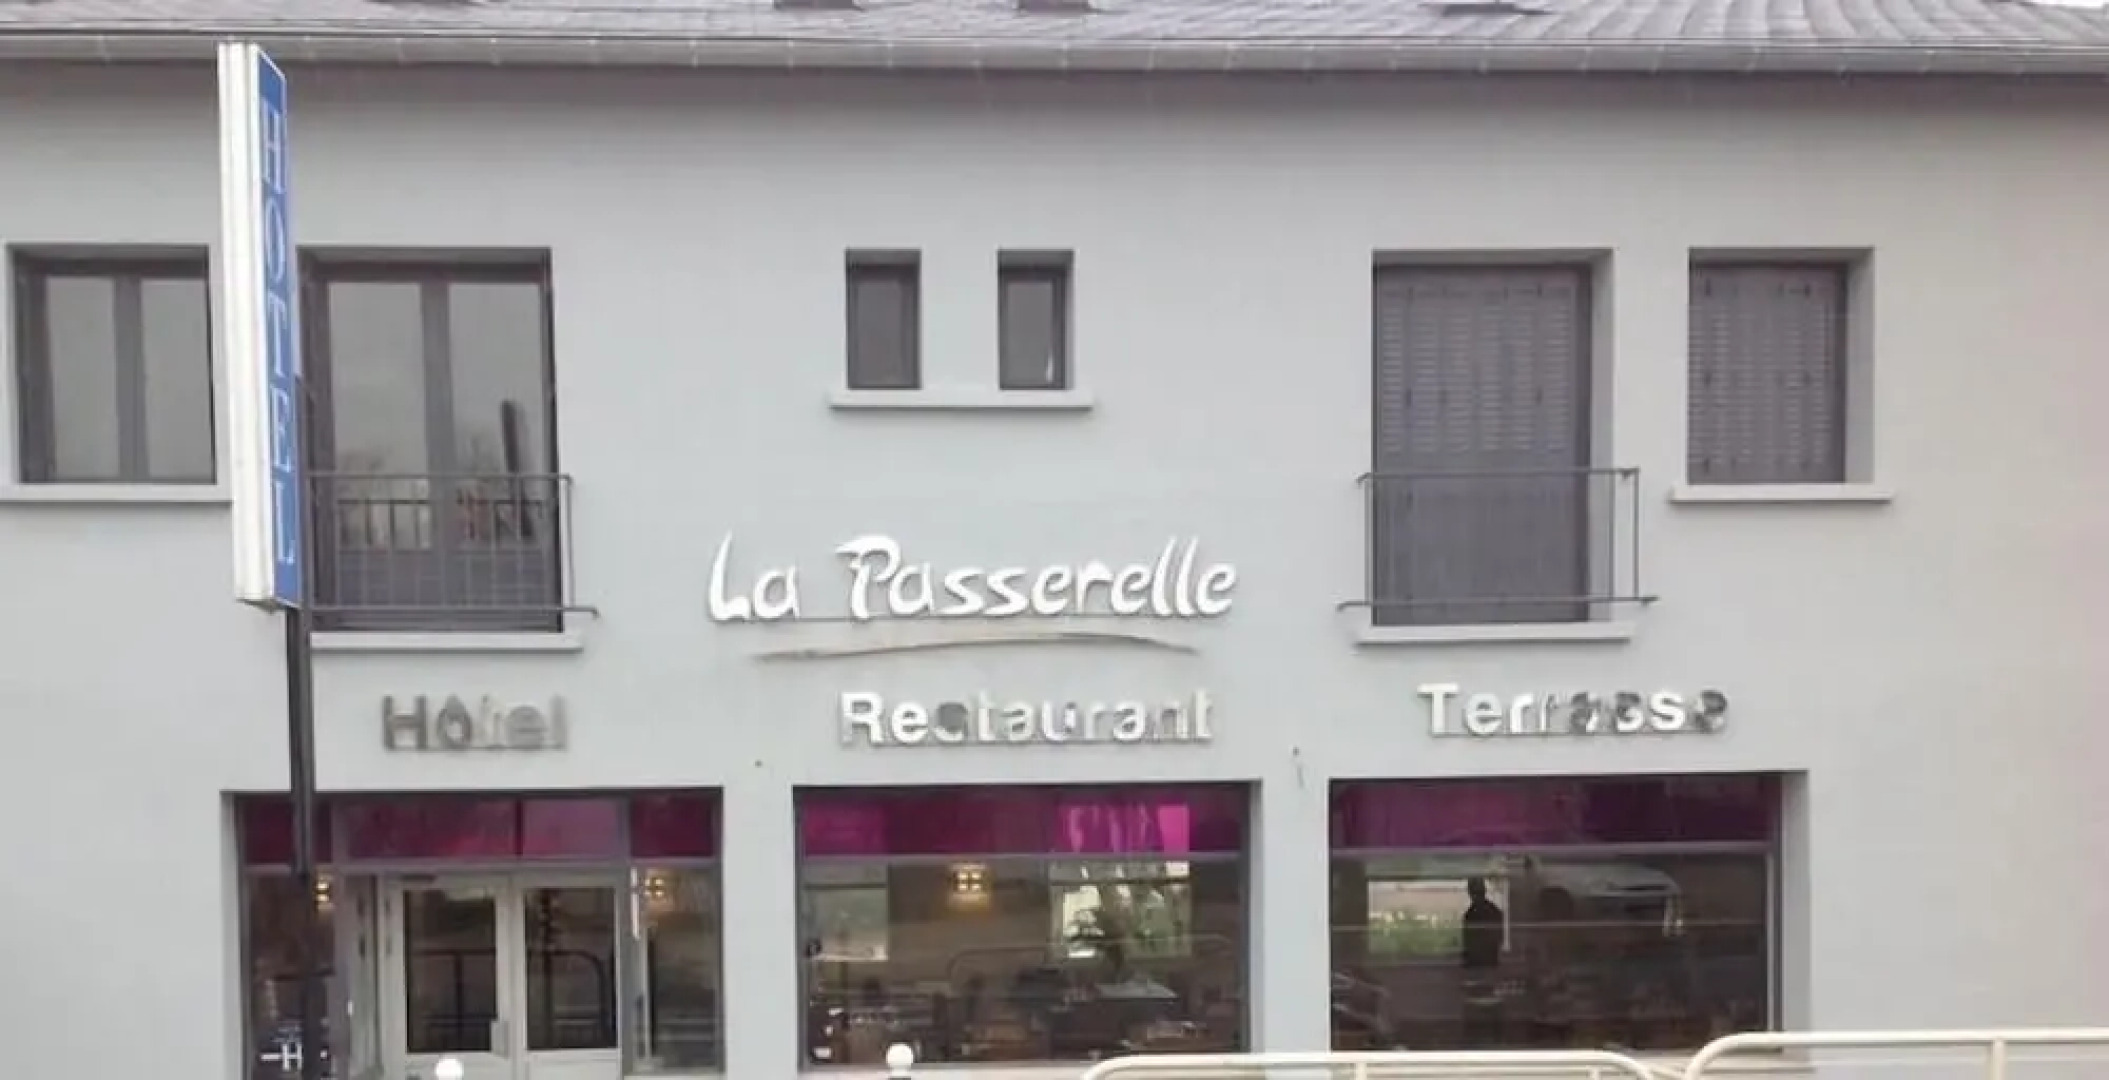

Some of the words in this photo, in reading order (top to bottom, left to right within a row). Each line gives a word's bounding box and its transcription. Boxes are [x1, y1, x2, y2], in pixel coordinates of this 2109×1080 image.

[258, 102, 295, 566] HOTEL
[708, 531, 799, 621] La
[834, 535, 1237, 620] Passerelle
[382, 694, 567, 751] Hôtel
[840, 689, 1214, 744] Restaurant
[1417, 682, 1728, 738] Terrasse
